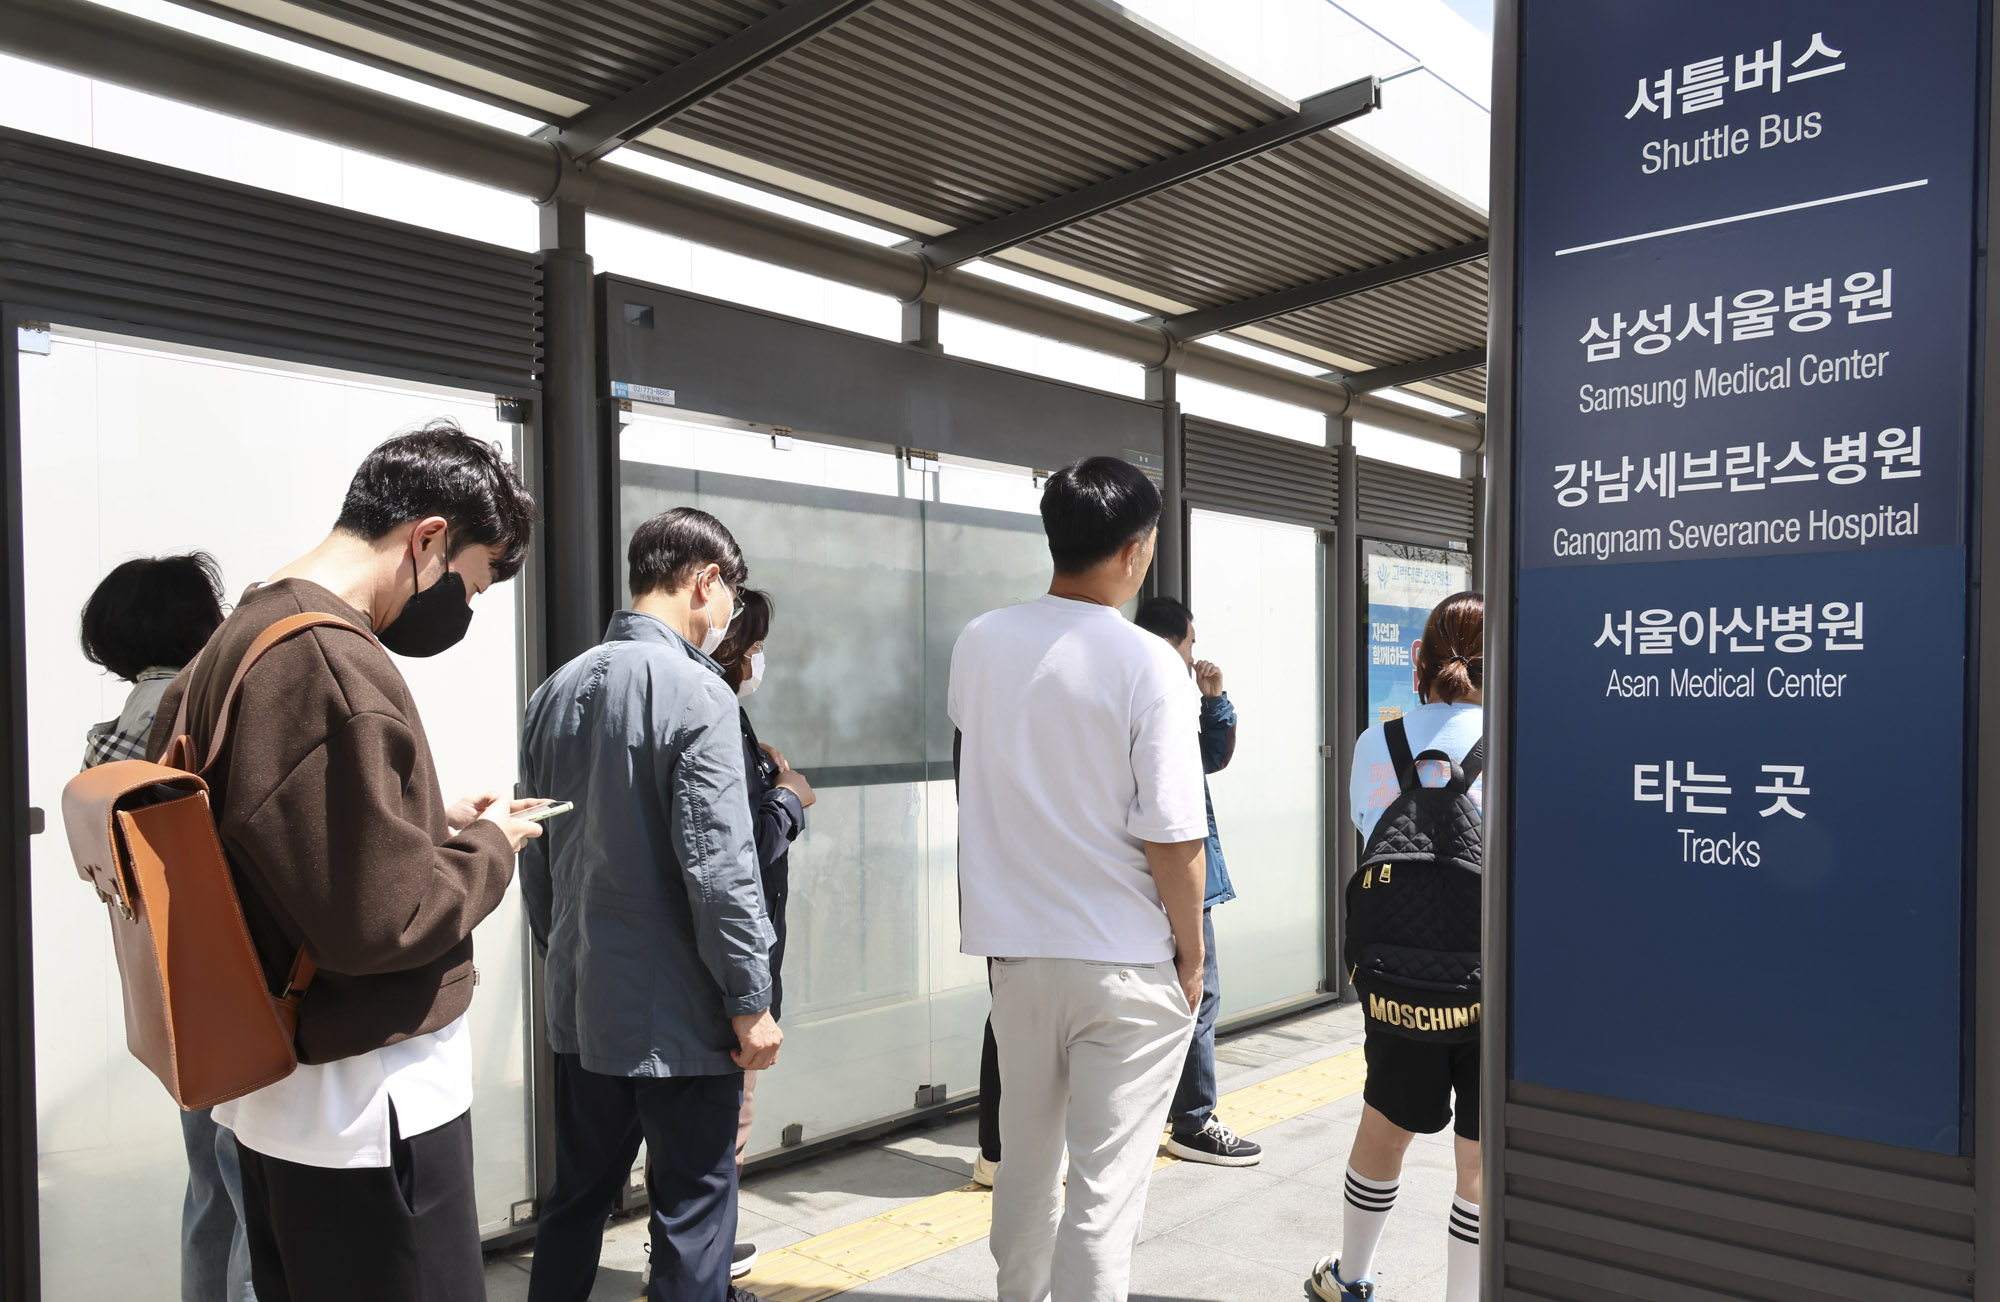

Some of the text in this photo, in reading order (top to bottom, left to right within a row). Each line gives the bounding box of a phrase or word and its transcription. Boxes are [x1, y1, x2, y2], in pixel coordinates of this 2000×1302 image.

[1625, 31, 1846, 120] 셔틀버스
[1641, 111, 1822, 175] Shuttle Bus
[1579, 267, 1893, 363] 삼성서울병원
[1579, 349, 1890, 414] Samsung Medical Center
[1553, 425, 1922, 508] 강남세브란스병원
[1553, 502, 1919, 561] Gangnam Severance Hospital
[1372, 622, 1400, 643] 자연과
[1372, 645, 1410, 666] 함께하는
[1594, 601, 1864, 655] 서울아산병원
[1605, 666, 1847, 698] Asan Medical Center
[1633, 760, 1811, 820] 타는 곳
[1677, 828, 1761, 868] Tracks
[1369, 992, 1481, 1031] MOSCHINO
